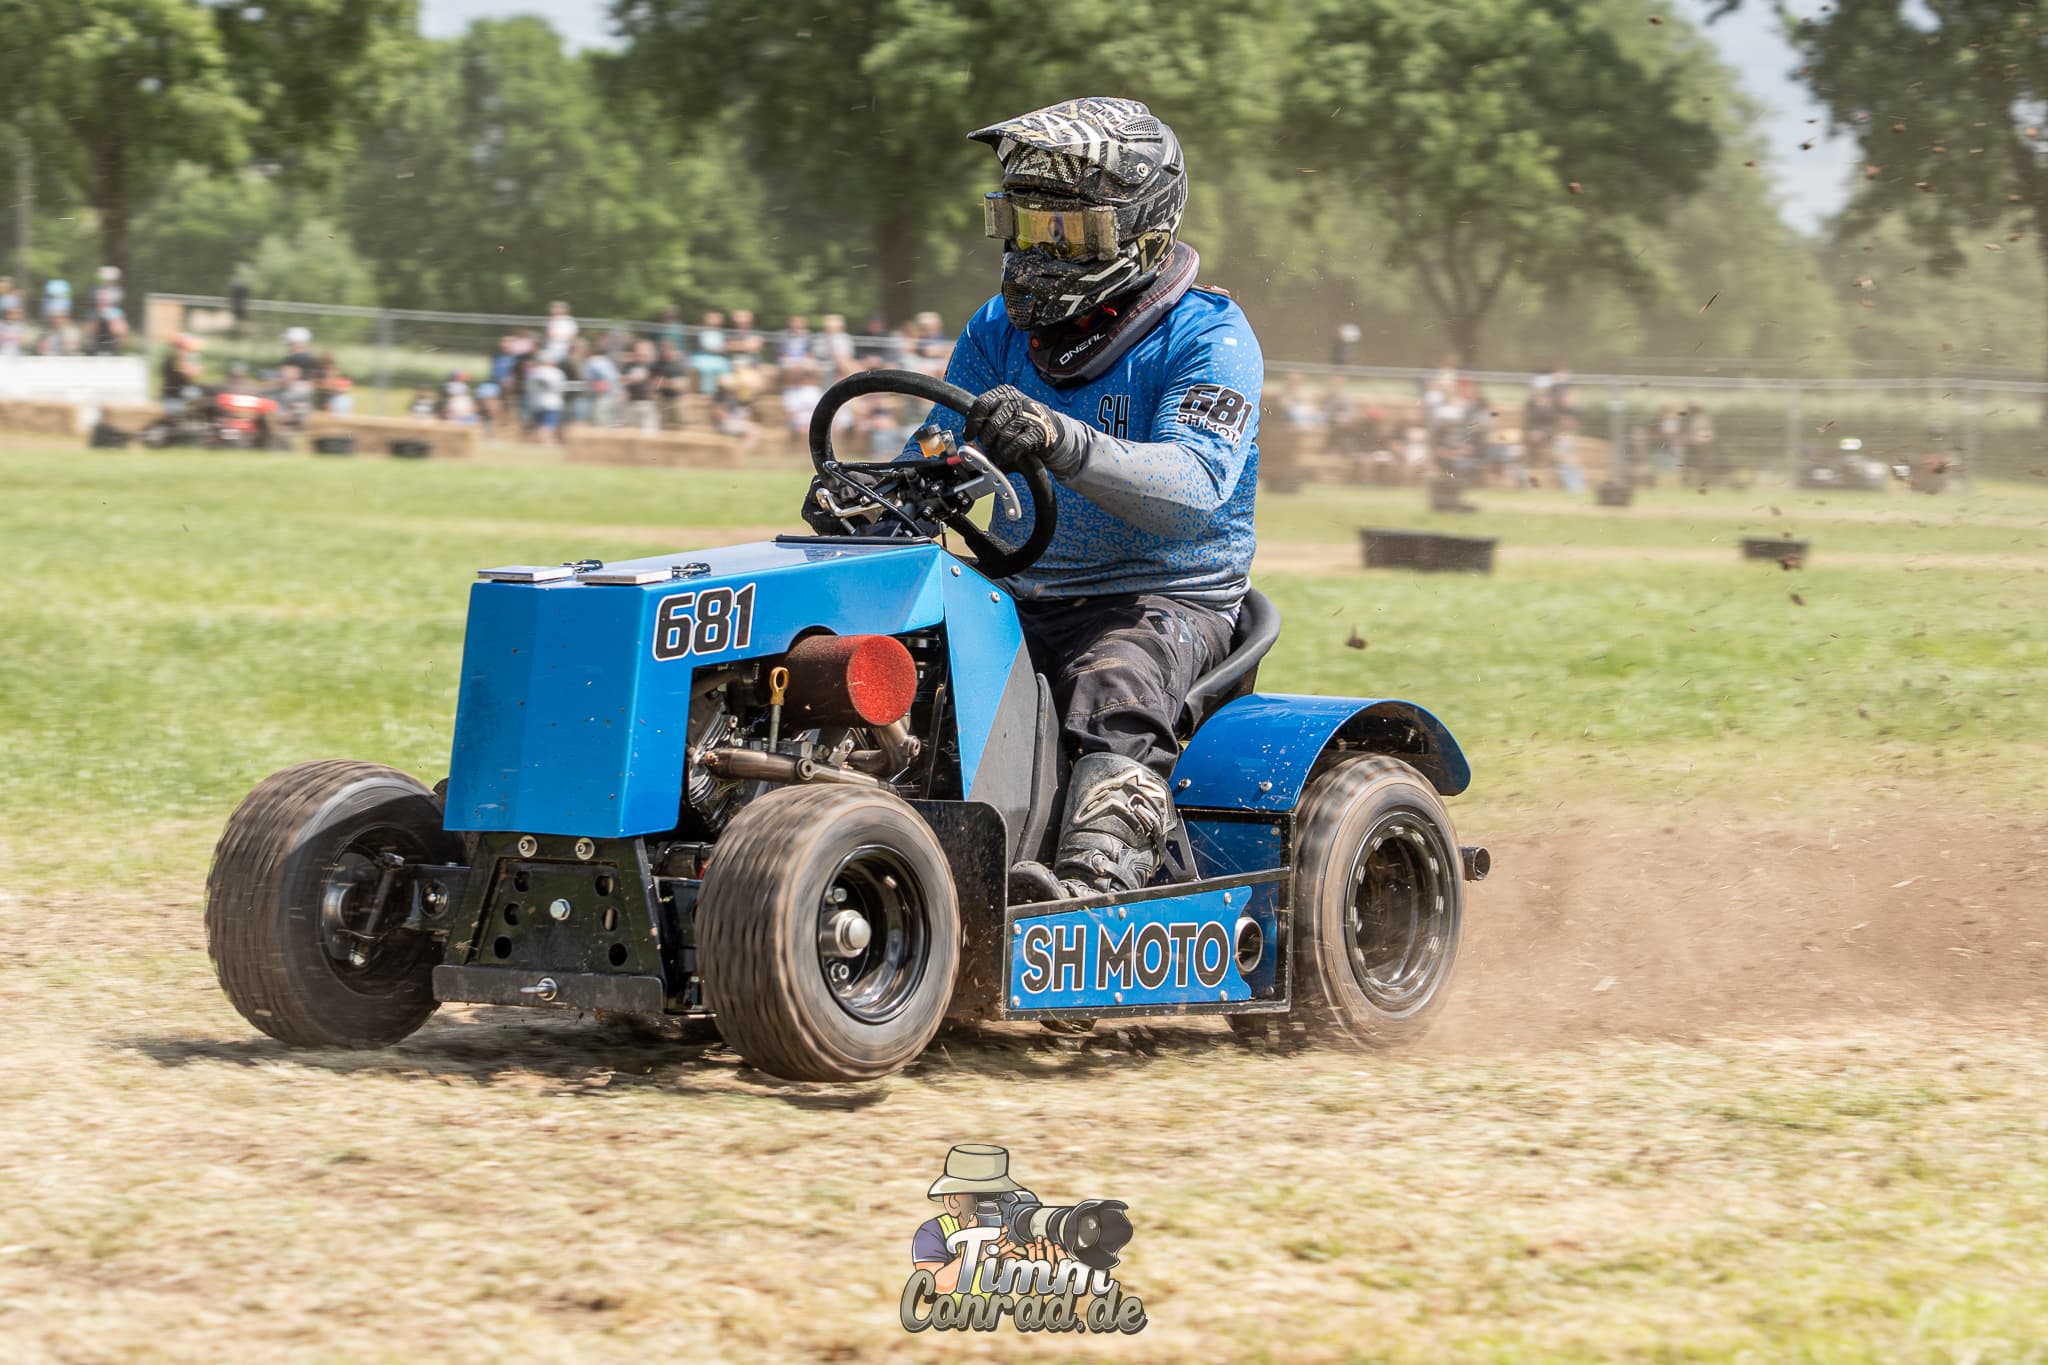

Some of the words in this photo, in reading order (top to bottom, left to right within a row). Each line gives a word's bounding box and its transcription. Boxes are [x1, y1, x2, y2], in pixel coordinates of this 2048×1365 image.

[1097, 394, 1131, 440] SH
[1175, 414, 1201, 427] SH
[1204, 420, 1240, 453] MOT
[1178, 384, 1254, 435] 681
[652, 582, 757, 662] 681
[1021, 923, 1087, 994] SH
[1096, 921, 1230, 991] MOTO
